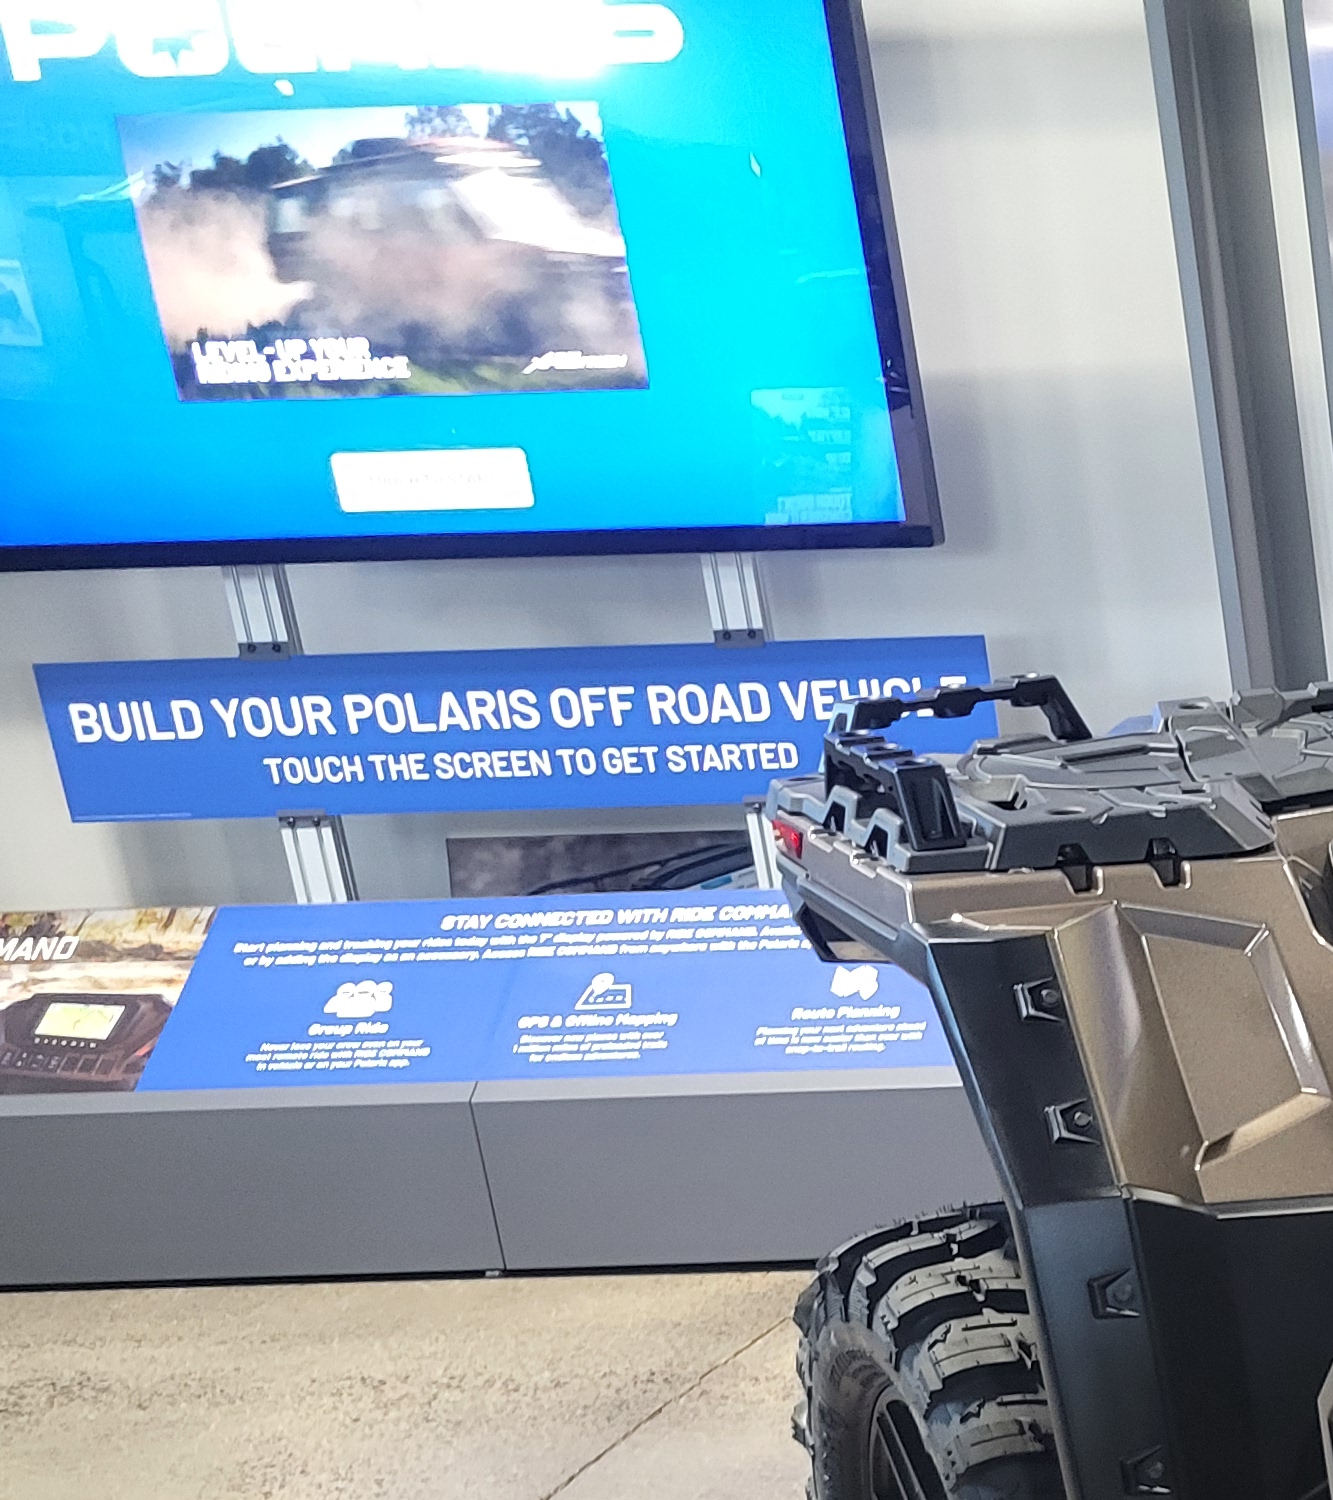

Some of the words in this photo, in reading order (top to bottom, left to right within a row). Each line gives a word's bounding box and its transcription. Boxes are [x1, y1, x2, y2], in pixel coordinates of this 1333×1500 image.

[68, 698, 204, 744] BUILD
[211, 694, 337, 739] YOUR
[343, 689, 541, 735] POLARIS
[550, 686, 635, 730] OFF
[646, 681, 771, 726] ROAD
[778, 675, 967, 722] VEHIC
[263, 755, 365, 786] TOUCH
[367, 753, 430, 782] THE
[434, 749, 552, 780] SCREEN
[556, 747, 597, 776] TO
[602, 745, 658, 774] GET
[665, 742, 799, 773] STARTED
[440, 914, 492, 931] STAY
[494, 910, 614, 930] CONNECTED
[617, 907, 668, 925] WITH
[670, 905, 718, 924] RIDE
[719, 904, 793, 922] COMMA
[615, 1011, 679, 1027] Mapping
[791, 1007, 835, 1021] Route
[837, 1004, 901, 1020] Planning
[308, 1022, 353, 1037] Group
[354, 1021, 389, 1035] Ride
